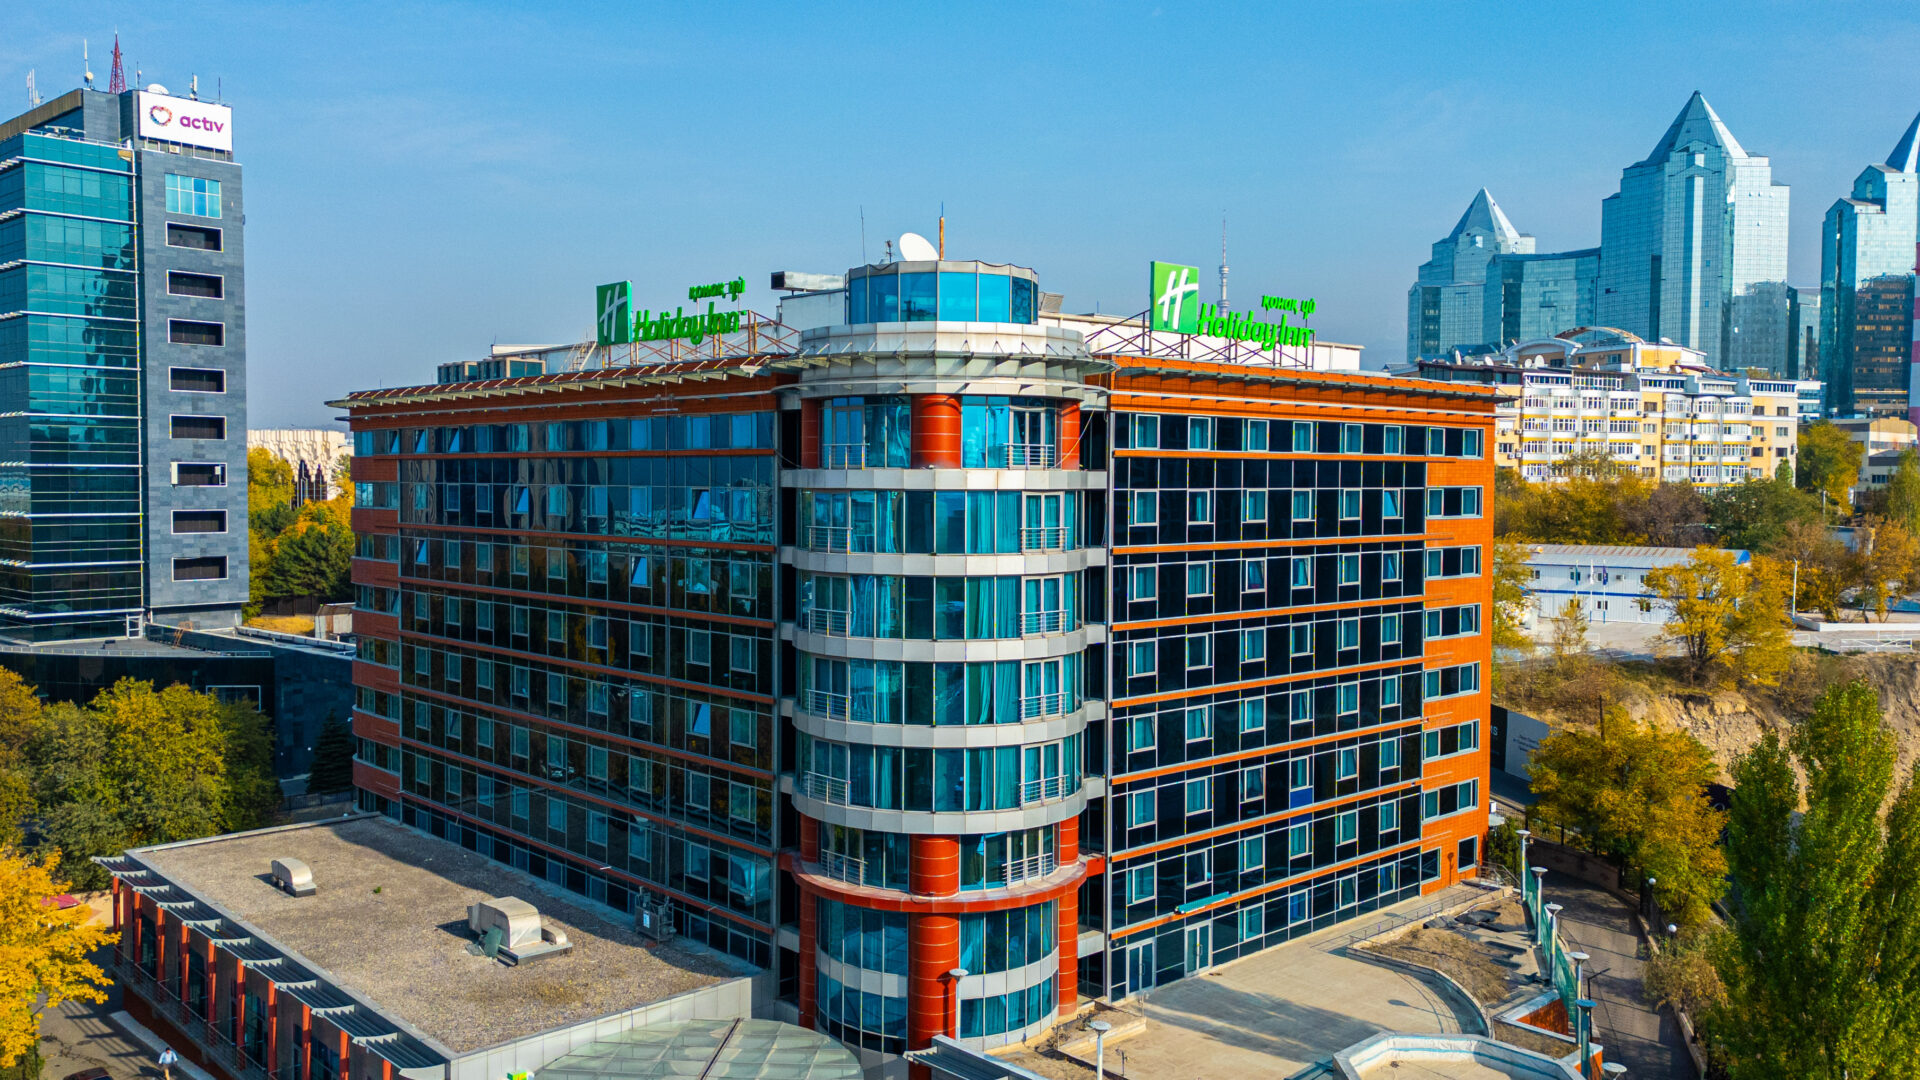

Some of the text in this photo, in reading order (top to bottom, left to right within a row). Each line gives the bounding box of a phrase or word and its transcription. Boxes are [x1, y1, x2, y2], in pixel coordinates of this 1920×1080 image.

[180, 116, 224, 133] activ
[633, 301, 739, 345] Holiday Inn
[1197, 303, 1311, 352] Holiday Inn
